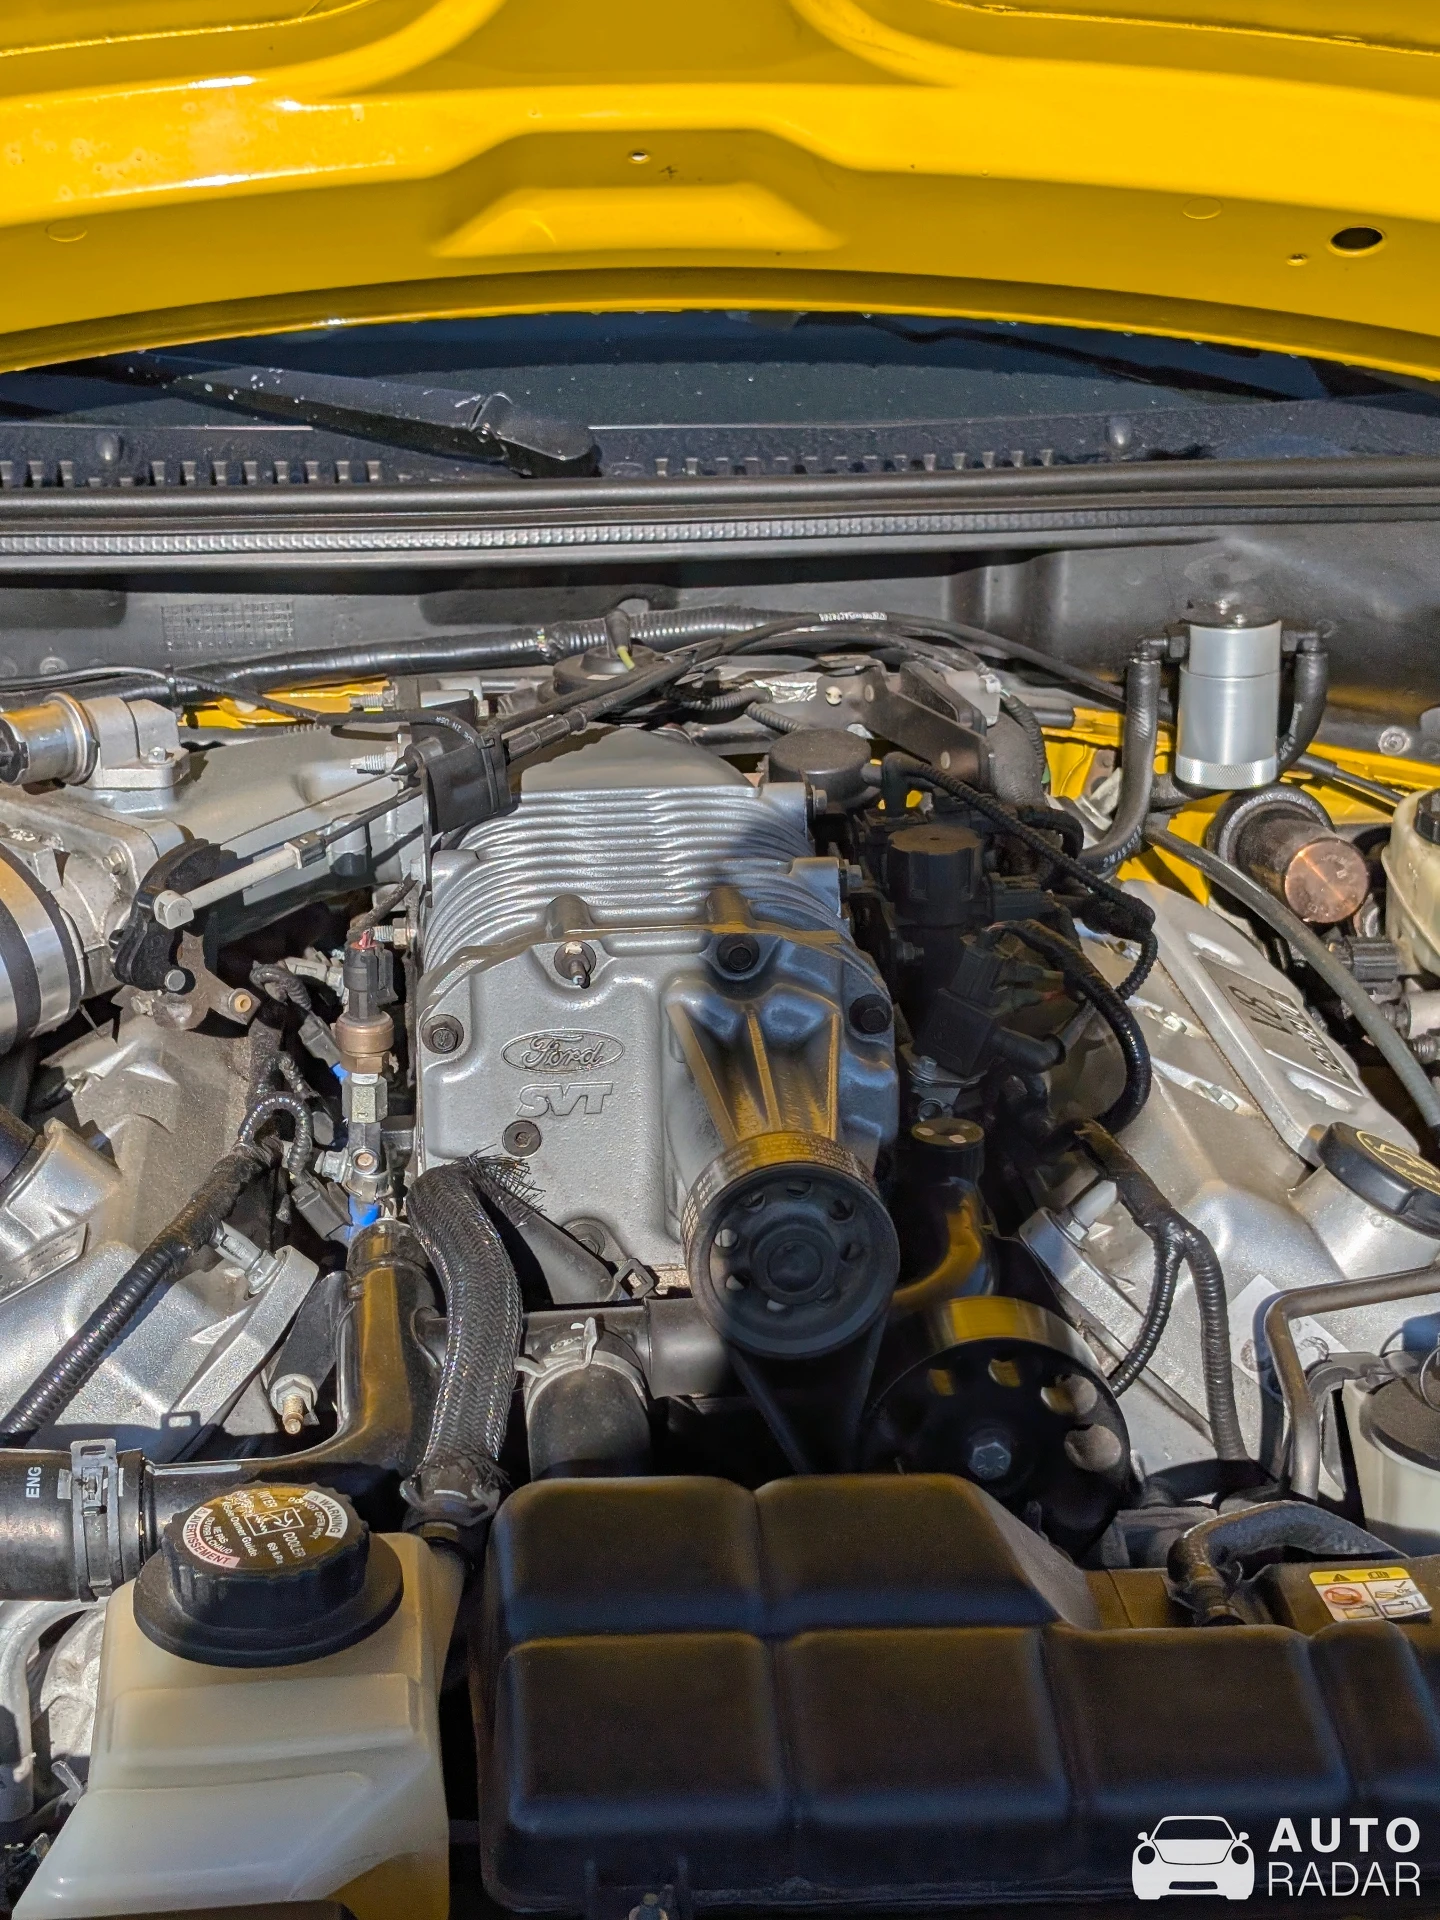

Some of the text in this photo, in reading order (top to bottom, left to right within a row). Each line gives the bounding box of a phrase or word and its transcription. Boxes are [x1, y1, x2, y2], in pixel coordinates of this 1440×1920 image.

[521, 1034, 605, 1068] Ford
[515, 1082, 613, 1118] SVT
[25, 1466, 42, 1498] ENG
[301, 1502, 319, 1512] NOT
[315, 1511, 326, 1525] OPEN
[320, 1499, 342, 1534] WARNING
[186, 1514, 230, 1564] AVERTISSEMENT
[216, 1533, 229, 1544] PAS
[230, 1516, 247, 1536] Owner
[241, 1536, 257, 1557] Guide
[257, 1490, 306, 1558] INTER COOLER
[309, 1527, 324, 1539] HOT
[208, 1538, 233, 1554] CHAUD
